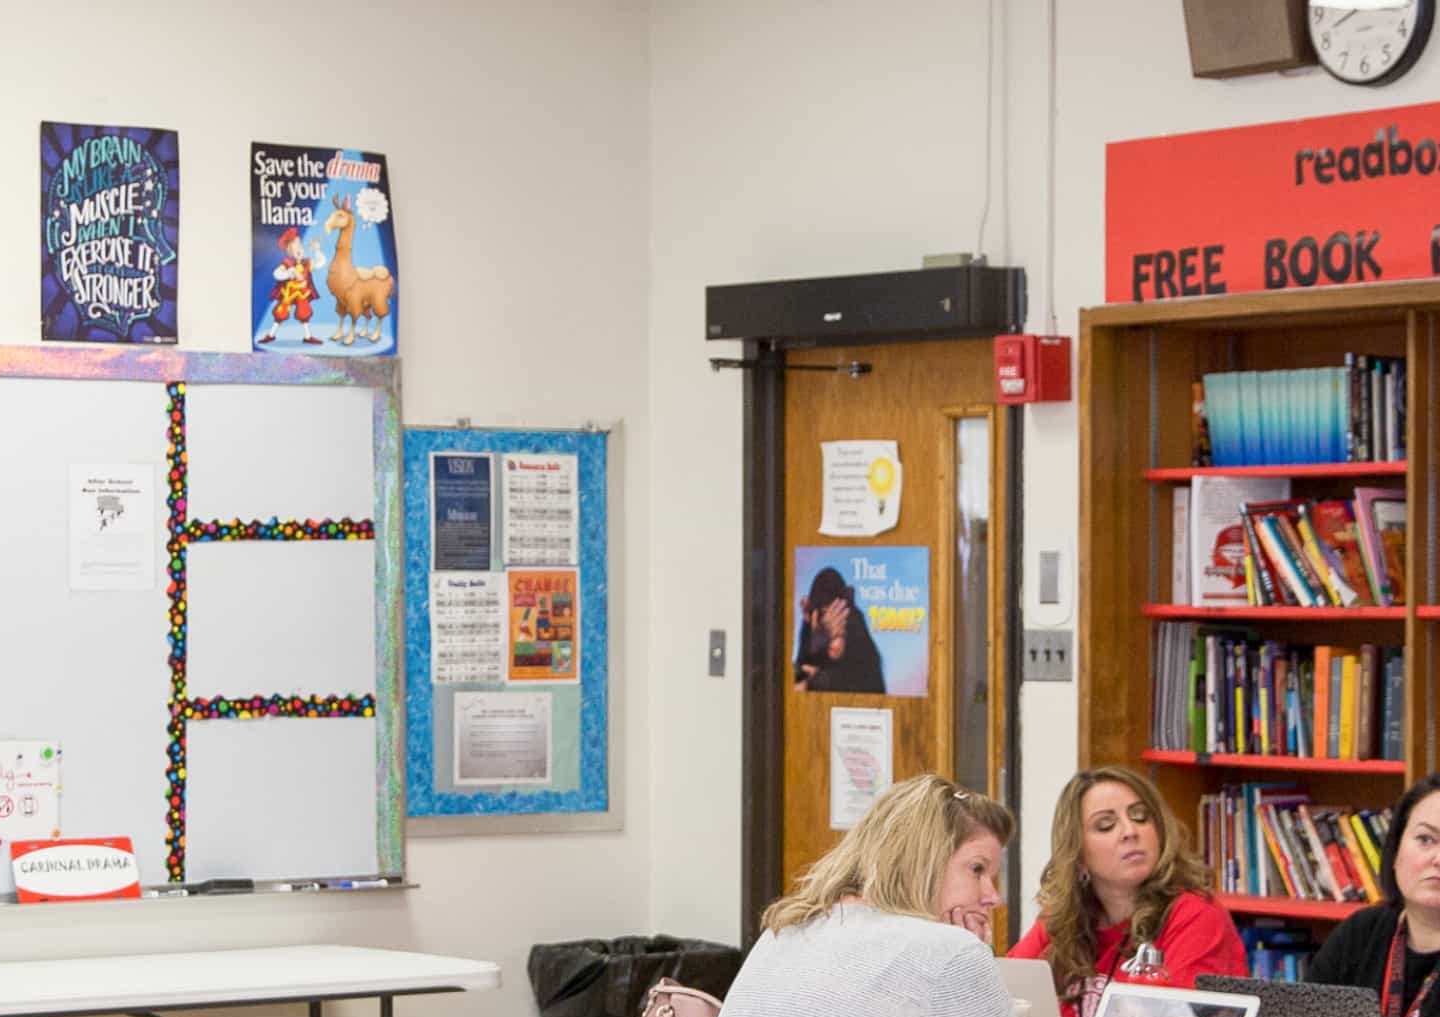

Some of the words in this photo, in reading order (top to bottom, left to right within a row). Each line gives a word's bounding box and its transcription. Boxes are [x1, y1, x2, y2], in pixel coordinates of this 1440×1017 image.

[1314, 6, 1324, 25] 9
[1398, 17, 1408, 39] 4
[1321, 31, 1331, 51] 8
[1338, 51, 1348, 71] 7
[1360, 54, 1370, 74] 6
[1381, 42, 1391, 65] 5
[59, 140, 90, 197] MY
[90, 136, 142, 169] BRAIN
[254, 150, 295, 177] Save
[297, 152, 325, 179] the
[259, 175, 285, 199] for
[288, 181, 328, 207] your
[61, 182, 144, 247] MUSCLE
[77, 220, 121, 242] WHEN
[61, 235, 135, 282] EXERCISE
[1132, 244, 1227, 303] FREE
[1263, 231, 1383, 290] BOOK
[849, 557, 887, 581] That
[859, 585, 888, 601] was
[888, 579, 921, 601] due
[20, 858, 84, 875] CARDINAL
[87, 855, 131, 871] DRAMA
